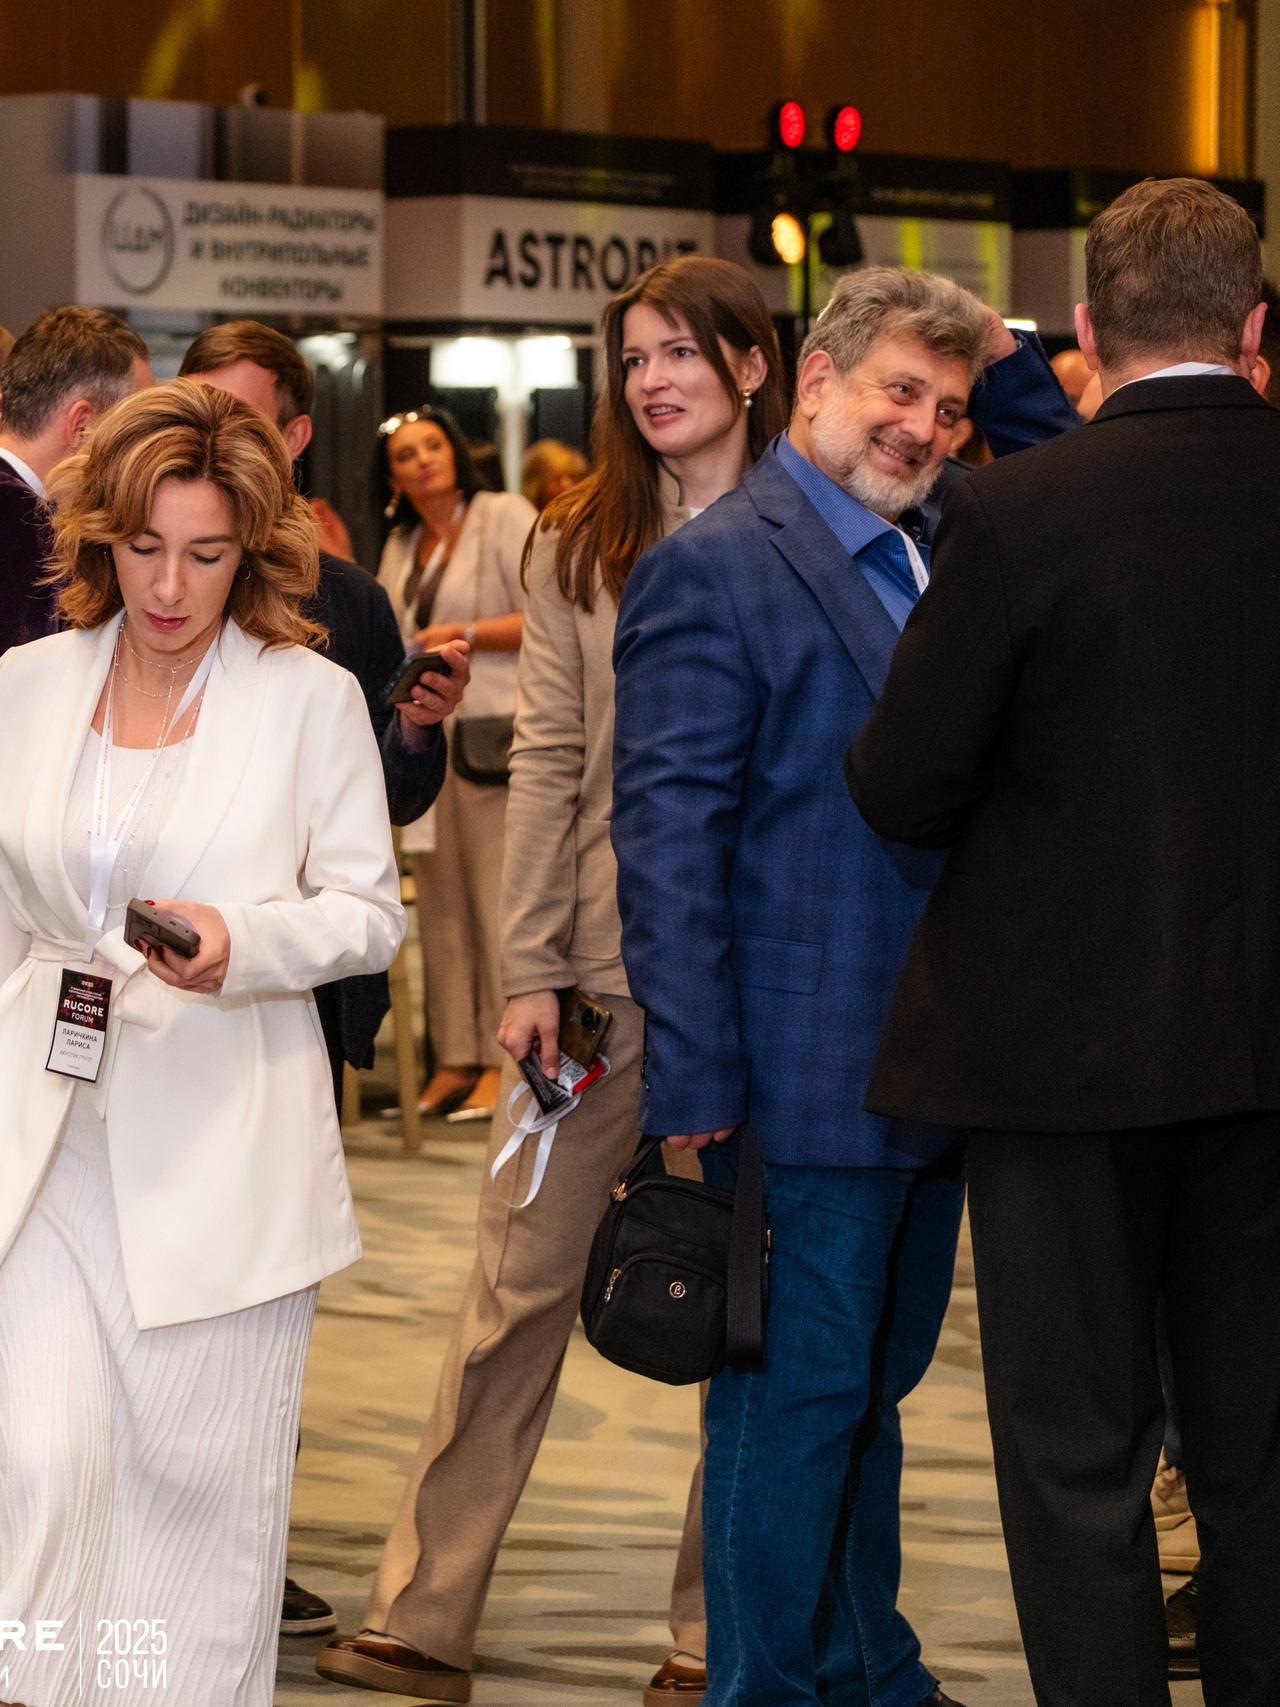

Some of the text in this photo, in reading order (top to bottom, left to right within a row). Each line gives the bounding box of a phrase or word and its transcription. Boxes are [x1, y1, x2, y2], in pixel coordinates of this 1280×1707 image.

[483, 228, 698, 292] ASTRO
[63, 998, 104, 1017] RUCORE
[71, 1012, 94, 1024] FORUM
[66, 1038, 91, 1050] ЛАРИСА
